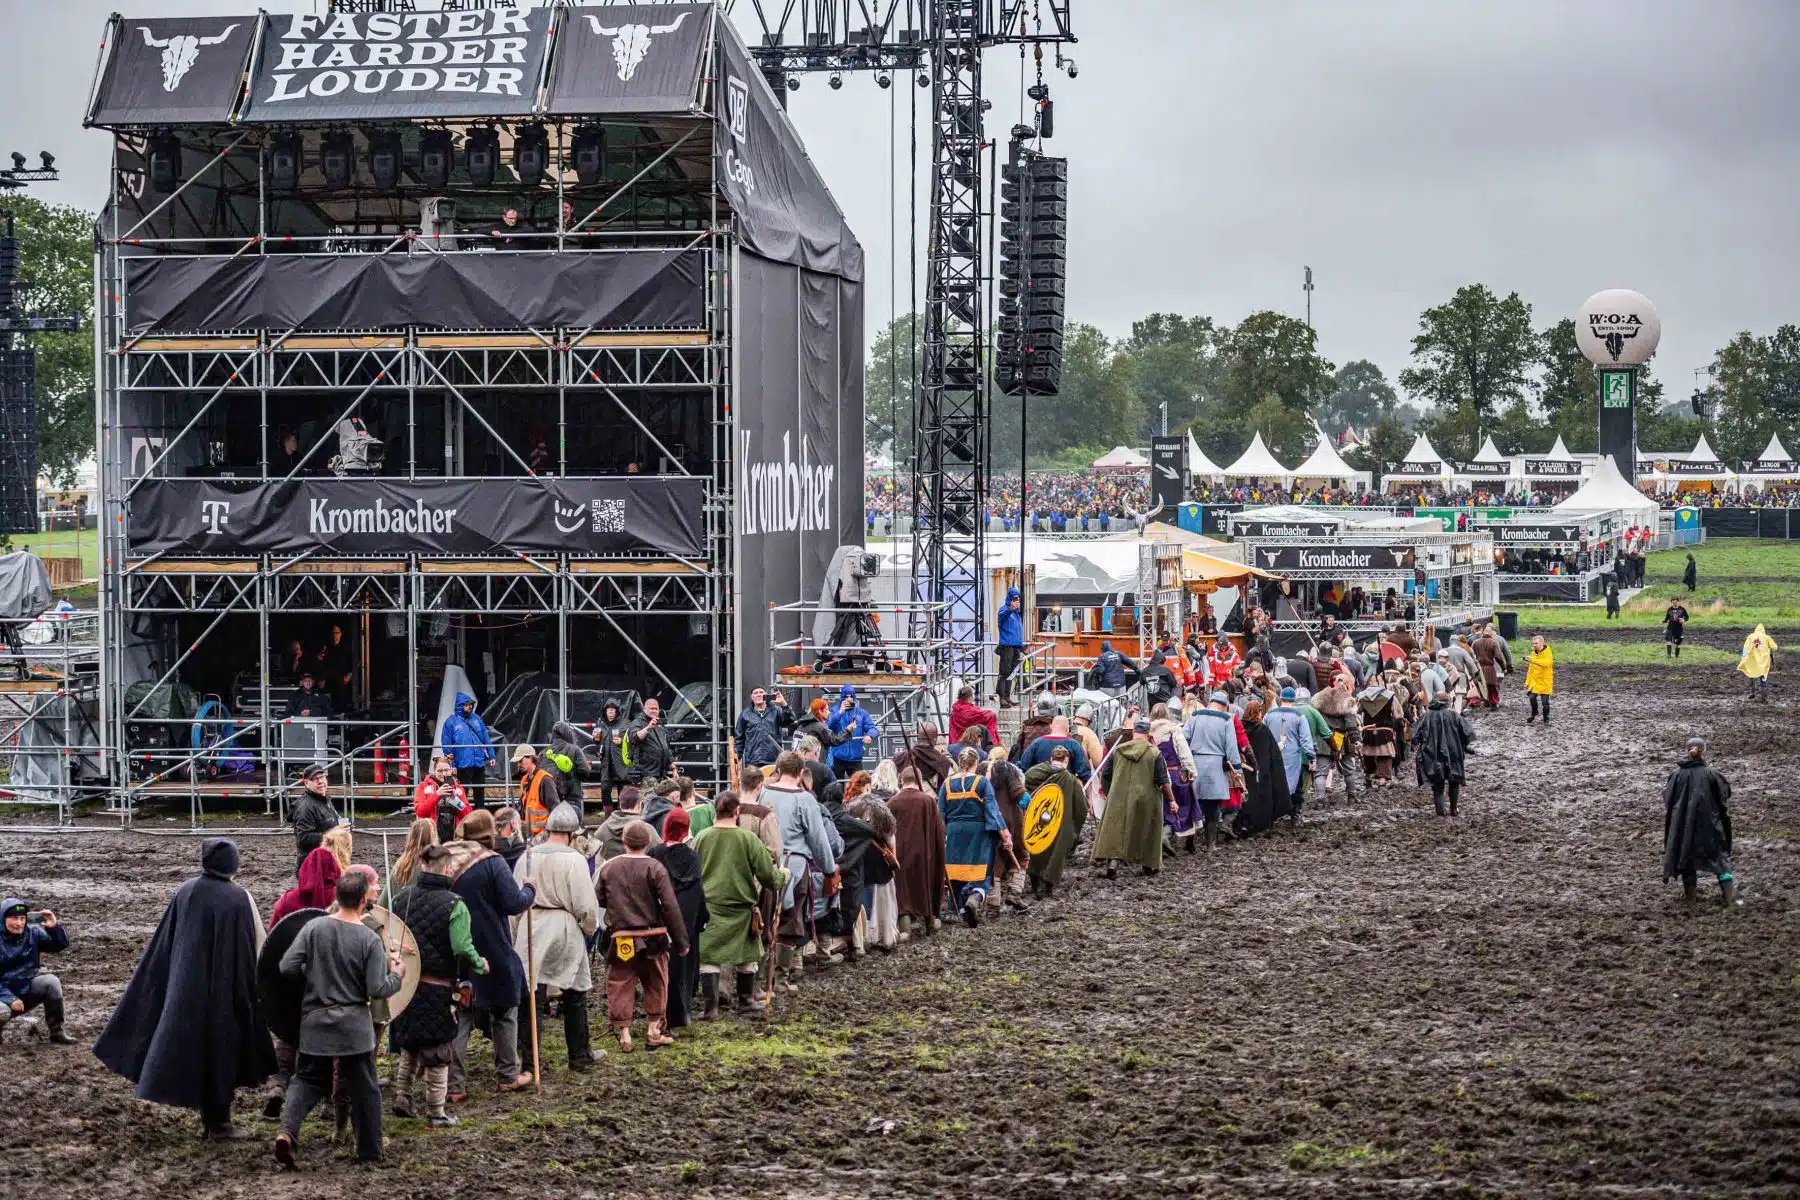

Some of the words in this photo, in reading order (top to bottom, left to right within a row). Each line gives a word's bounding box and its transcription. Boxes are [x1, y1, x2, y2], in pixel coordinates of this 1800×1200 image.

[281, 7, 533, 41] FASTER
[272, 37, 528, 70] HARDER
[264, 67, 524, 103] LOUDER
[726, 149, 754, 196] Cago
[741, 430, 834, 536] Krombher
[202, 501, 230, 534] T
[309, 498, 457, 533] Krombacher
[1262, 524, 1309, 536] Krombacher
[1502, 528, 1550, 540] Krombacher
[1299, 550, 1371, 568] Krombacher
